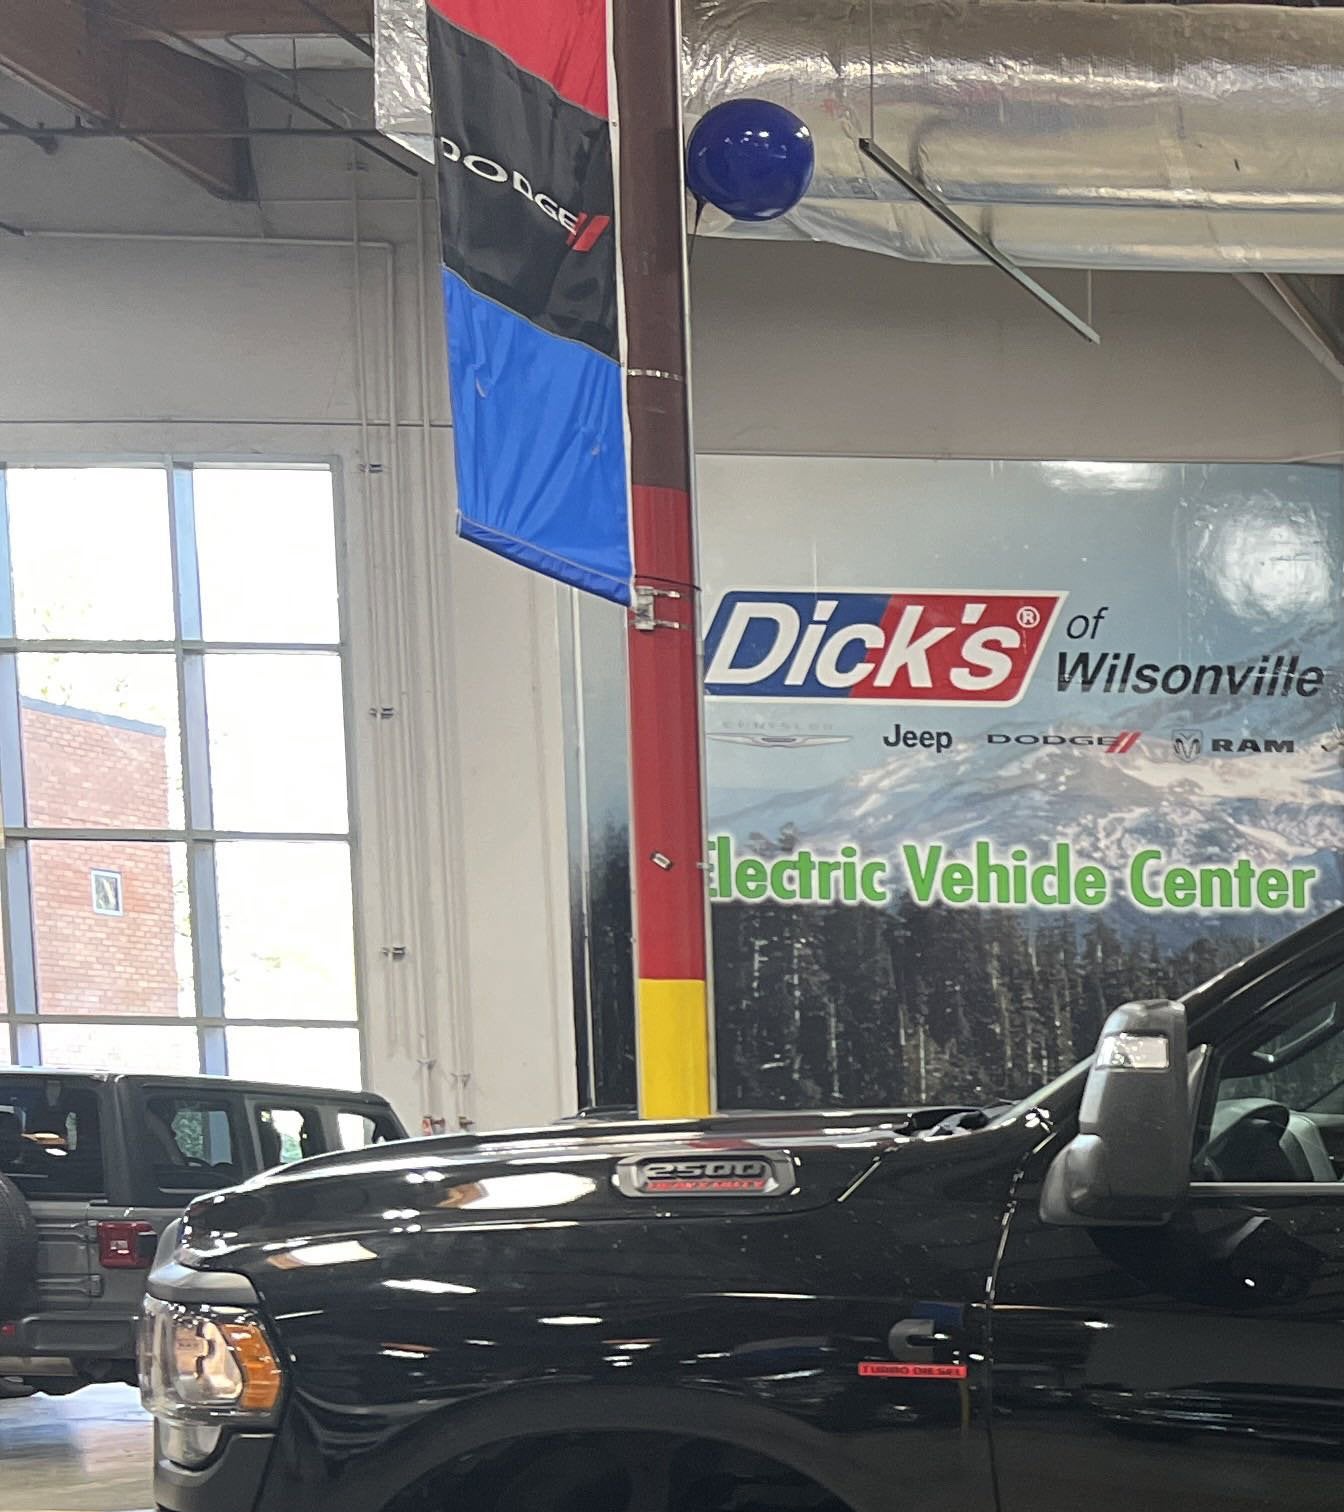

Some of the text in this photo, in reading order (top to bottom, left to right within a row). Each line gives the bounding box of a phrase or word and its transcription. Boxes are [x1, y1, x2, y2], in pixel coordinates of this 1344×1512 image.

[440, 137, 579, 236] DODGE
[1067, 607, 1109, 640] of
[1057, 651, 1324, 697] Wilsonville
[883, 724, 953, 753] Jeep
[987, 734, 1119, 746] DODGE
[1211, 738, 1295, 753] RAM
[903, 841, 1107, 906] Vehicle
[1130, 849, 1317, 909] Center
[645, 1162, 764, 1178] 2500
